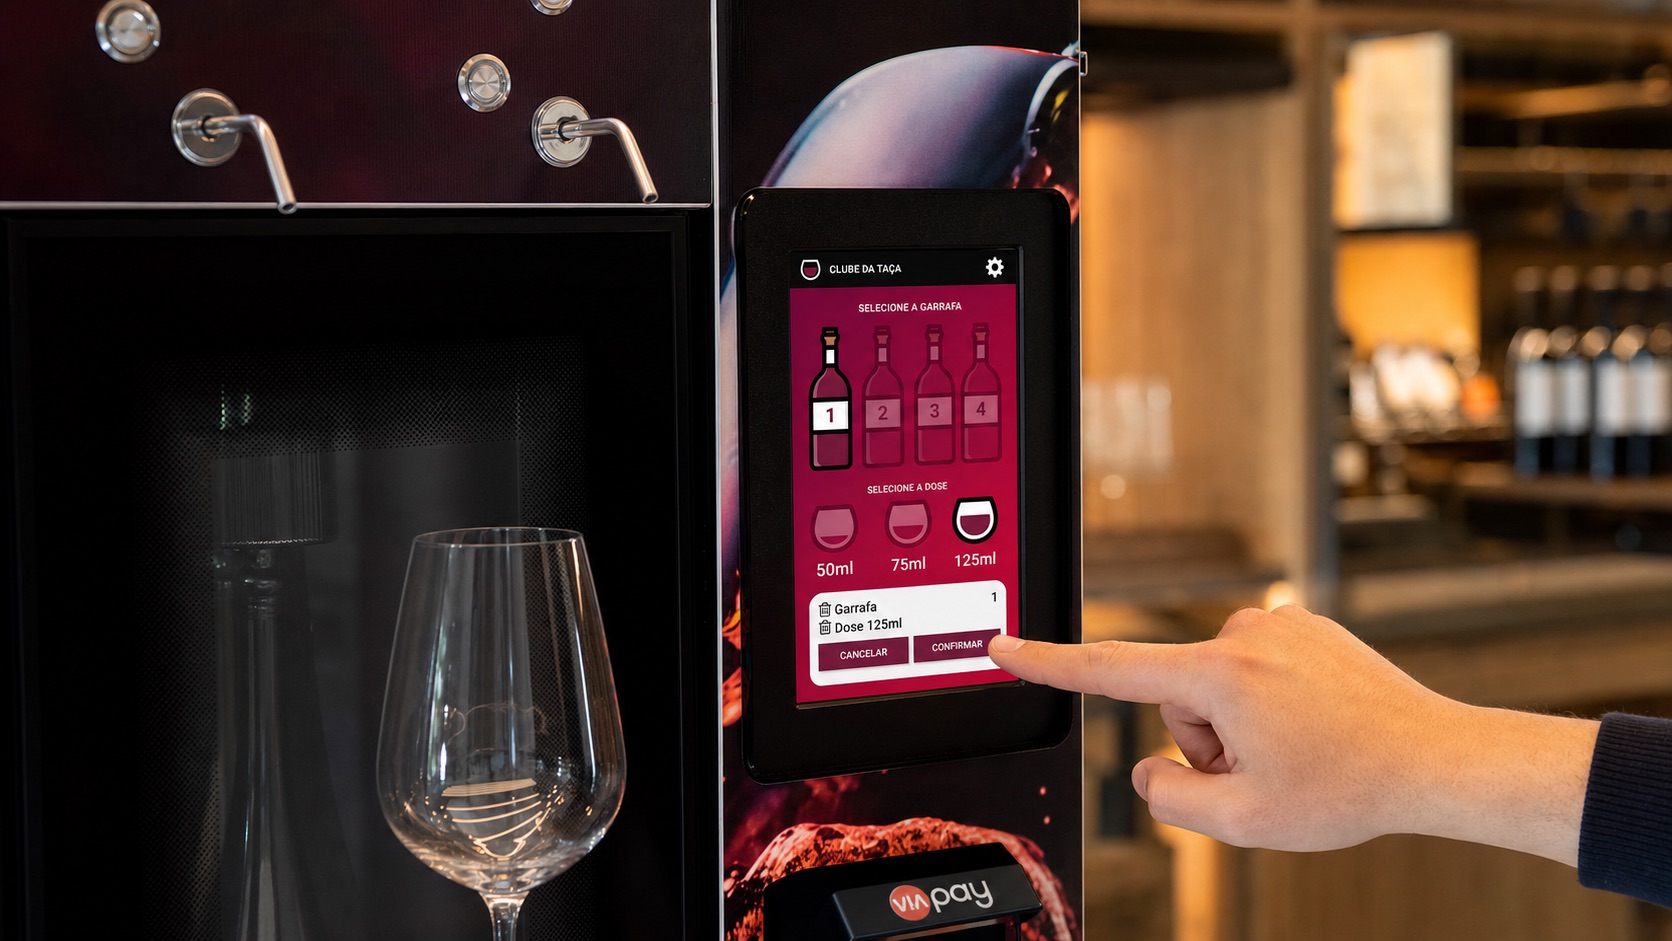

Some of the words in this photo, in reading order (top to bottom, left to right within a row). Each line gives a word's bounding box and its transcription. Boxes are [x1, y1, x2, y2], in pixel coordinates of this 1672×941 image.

[829, 265, 860, 274] CLUBE
[862, 265, 875, 274] DA
[877, 264, 902, 275] TAÇA
[858, 303, 909, 312] SELECIONE
[911, 303, 918, 311] A
[920, 302, 962, 311] GARRAFA
[826, 408, 833, 423] 1
[878, 406, 888, 420] 2
[930, 404, 940, 418] 3
[976, 402, 986, 416] 4
[867, 484, 915, 494] SELECIONE
[917, 483, 923, 491] A
[925, 482, 948, 491] DOSE
[891, 557, 926, 572] 75ml
[954, 552, 996, 567] 125ml
[817, 561, 853, 577] 50ml
[991, 591, 997, 602] 1
[835, 601, 877, 615] Garrafa
[836, 623, 864, 633] Dose
[868, 618, 902, 630] 125ml
[932, 640, 983, 651] CONFIRMAR
[840, 649, 888, 660] CANCELAR
[930, 880, 993, 913] pay
